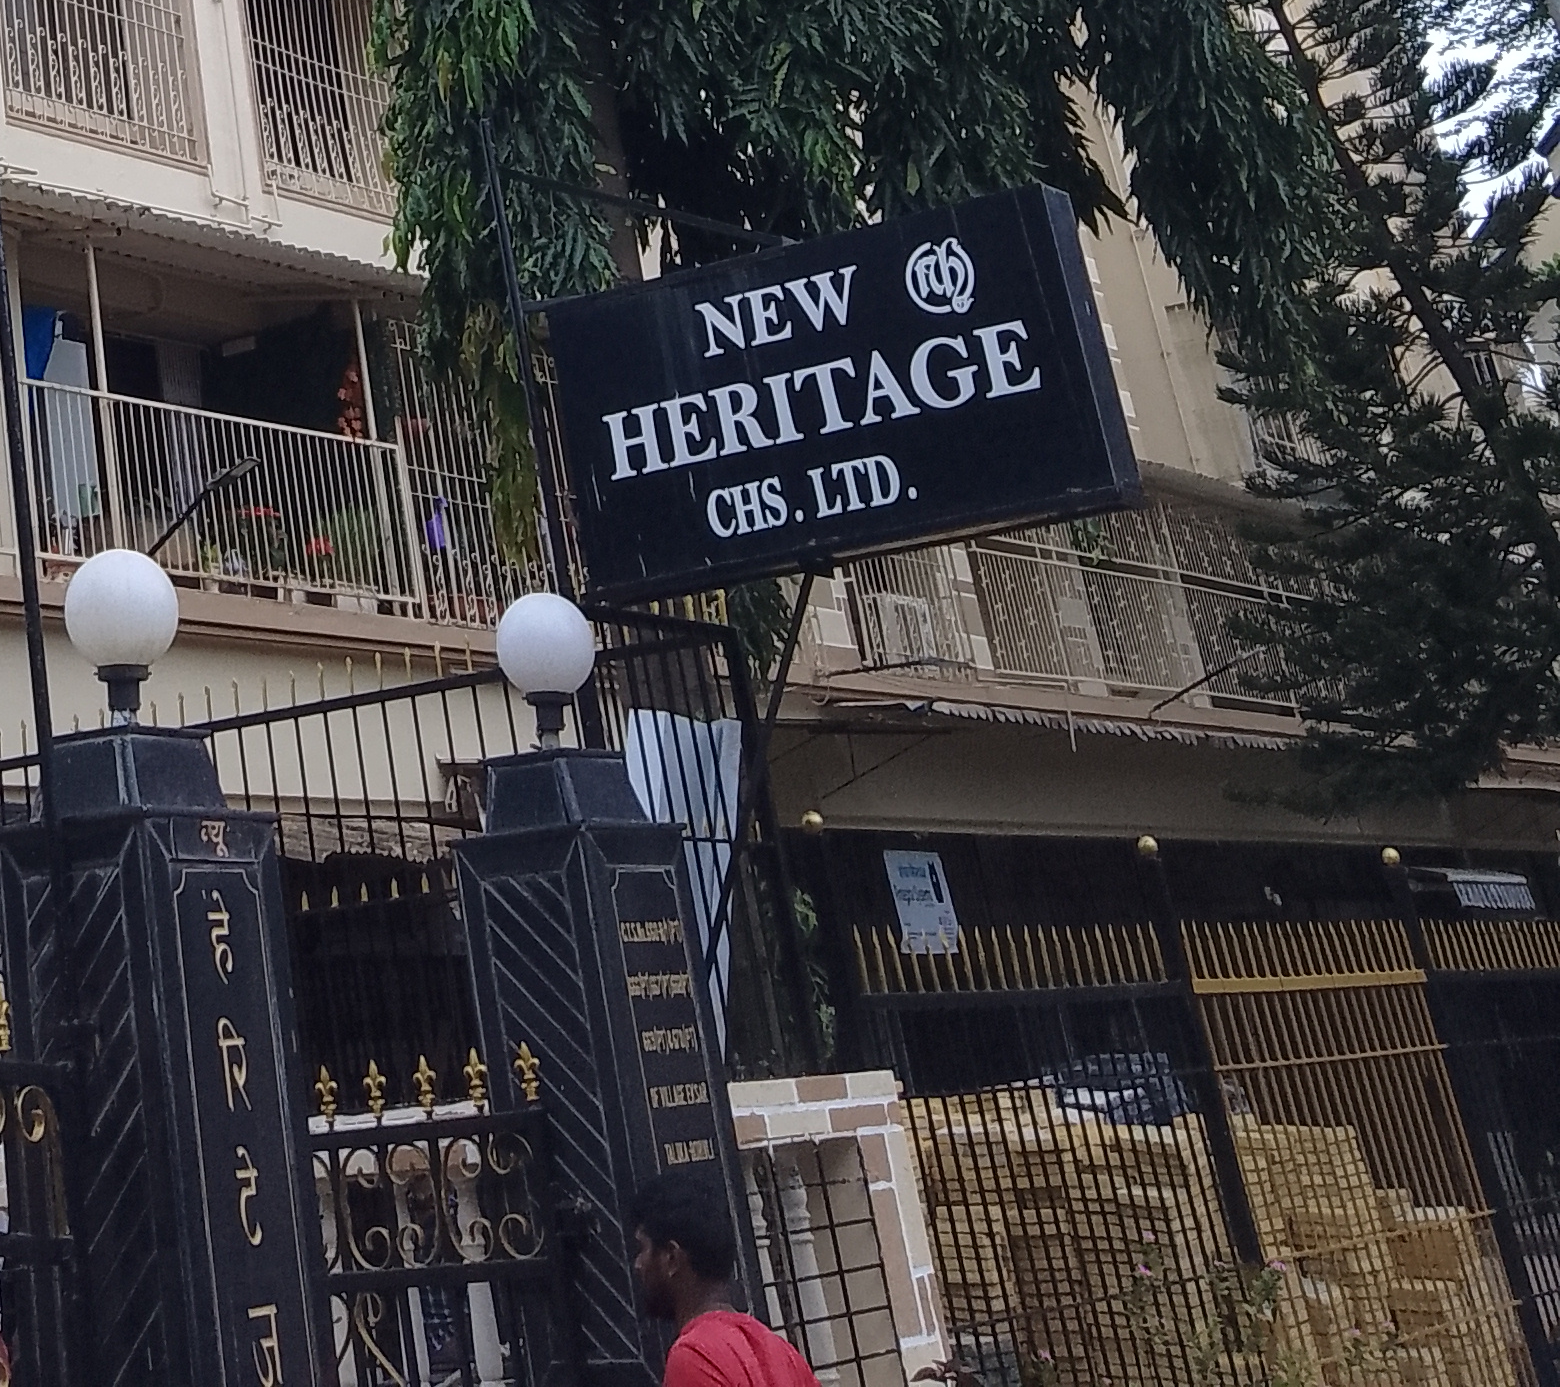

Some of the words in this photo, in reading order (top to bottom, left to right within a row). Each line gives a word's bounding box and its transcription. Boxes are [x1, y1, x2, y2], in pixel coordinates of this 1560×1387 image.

[695, 265, 857, 358] NEW
[602, 320, 1041, 481] HERITAGE
[706, 476, 804, 538] CHS.
[807, 455, 918, 519] LTD.
